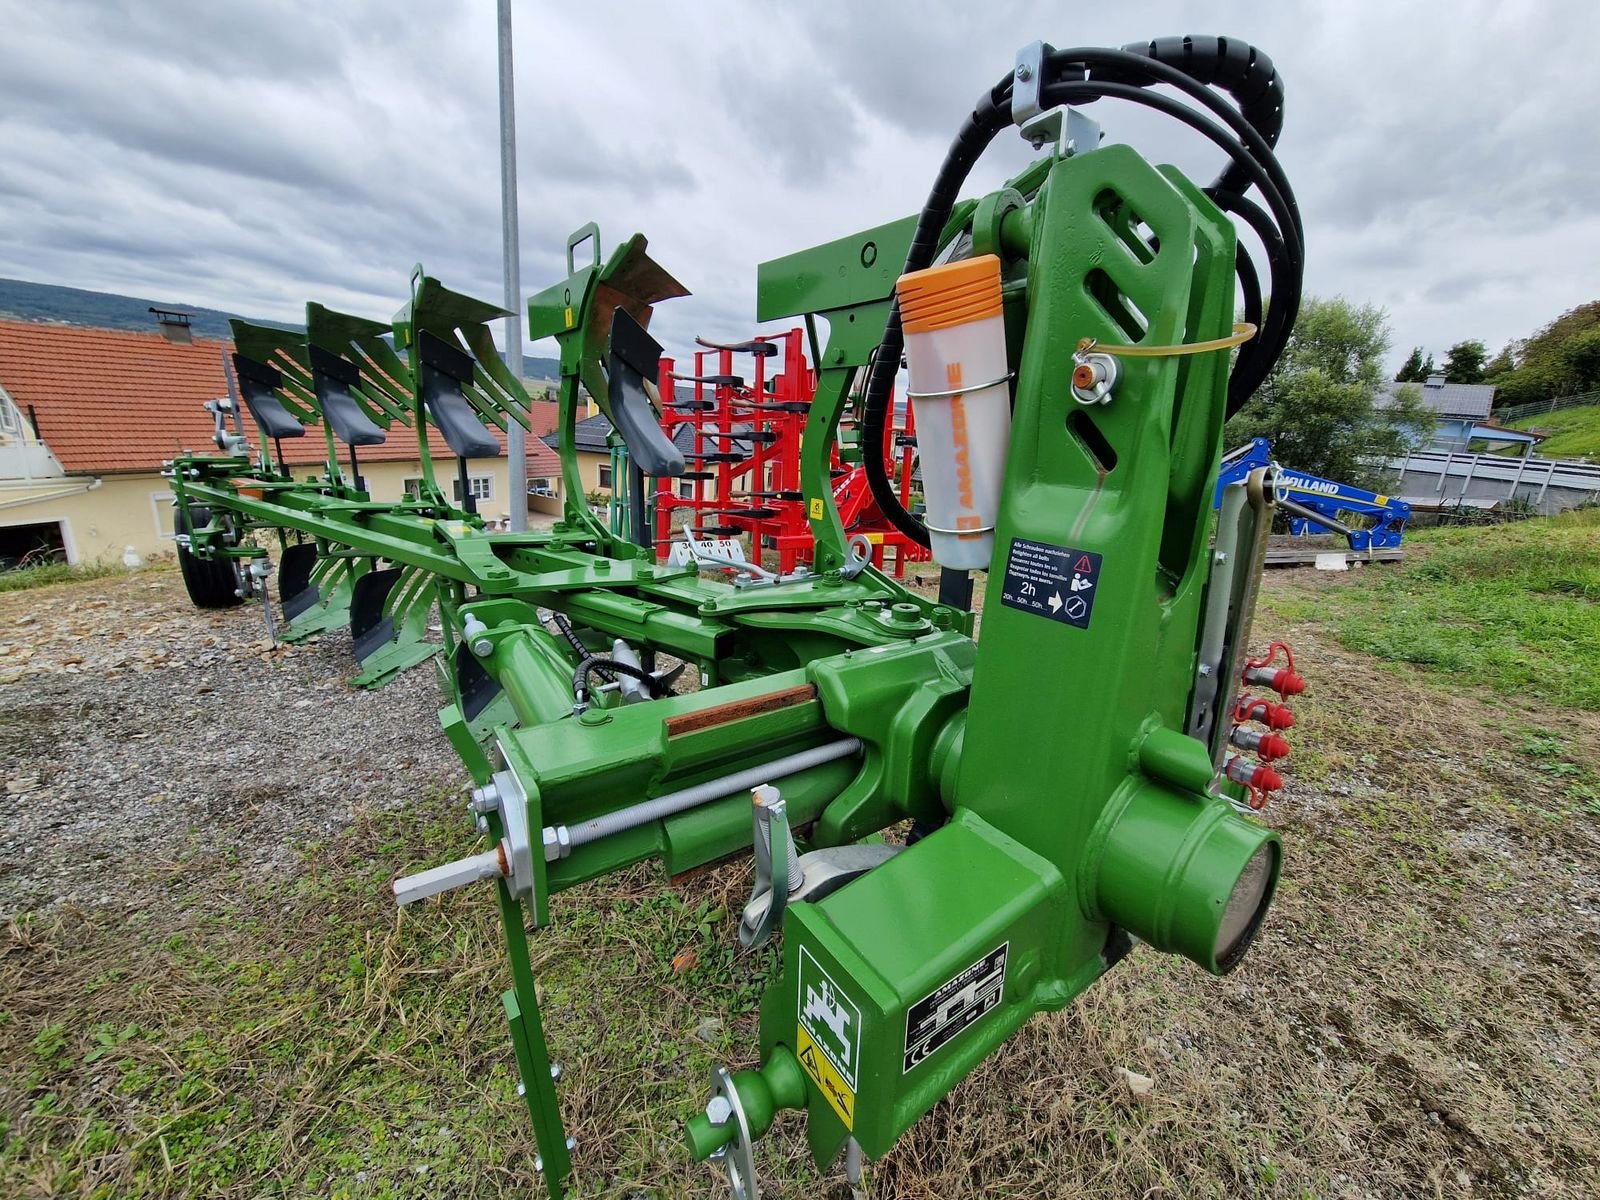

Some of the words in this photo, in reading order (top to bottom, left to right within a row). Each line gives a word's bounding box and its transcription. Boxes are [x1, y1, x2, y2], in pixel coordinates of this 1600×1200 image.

[946, 362, 974, 510] AMAZONE
[1284, 476, 1339, 495] OLLAND
[719, 540, 732, 548] 50
[1020, 581, 1036, 596] 2h
[934, 959, 986, 1000] AMAZONE
[800, 1014, 855, 1086] AMAZONE
[911, 1039, 931, 1064] CE
